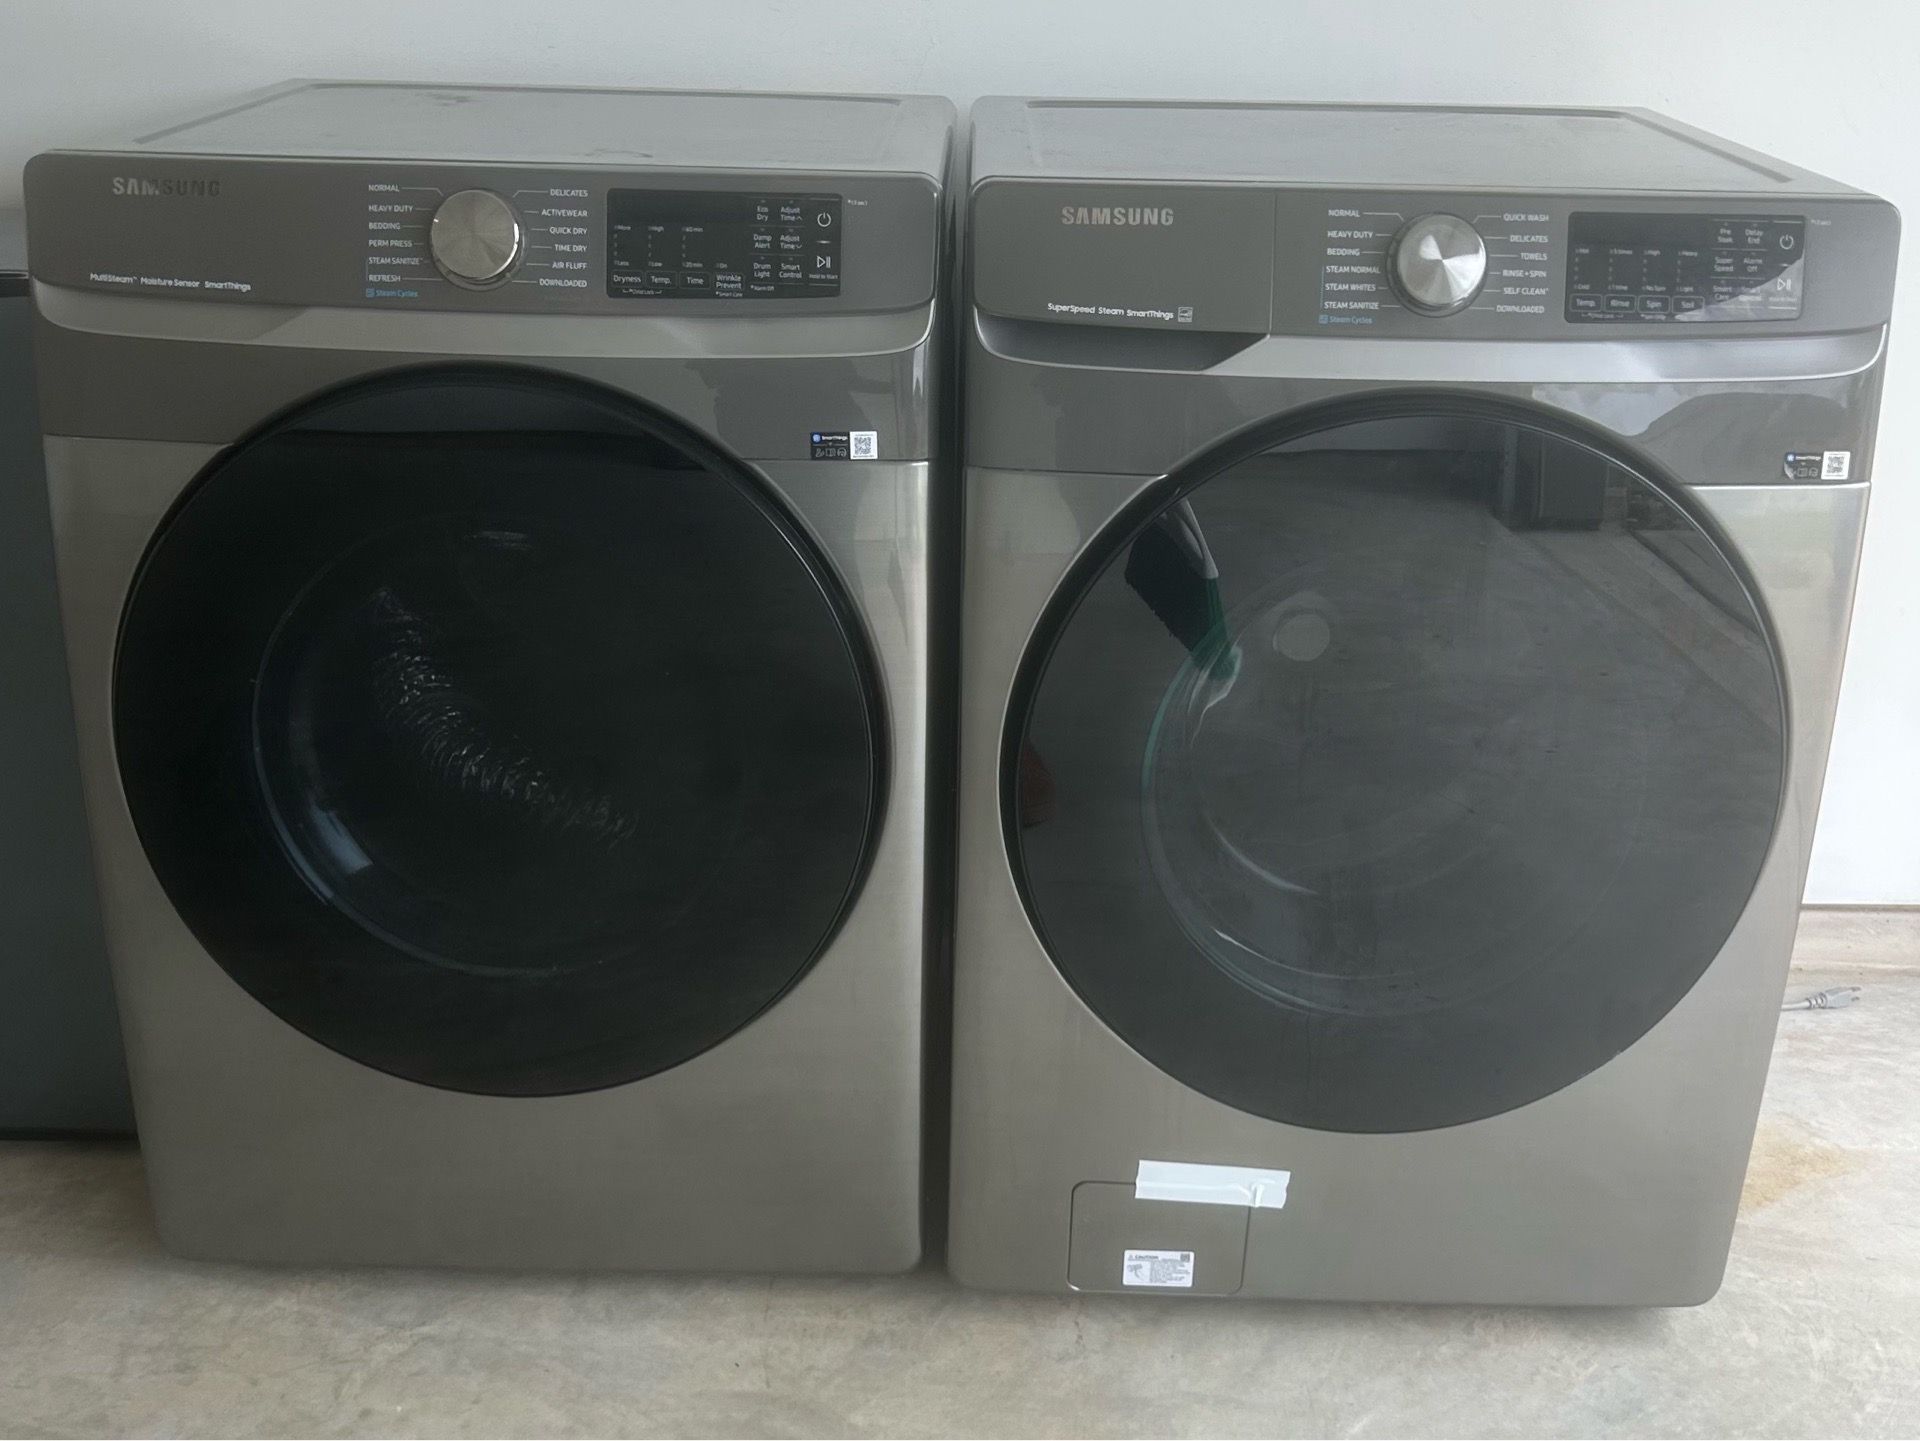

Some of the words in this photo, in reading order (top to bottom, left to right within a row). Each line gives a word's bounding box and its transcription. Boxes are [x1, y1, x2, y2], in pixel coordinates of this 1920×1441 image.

[112, 176, 221, 197] SAMSUNG
[368, 184, 400, 193] NORMAL
[550, 188, 589, 198] DELICATES
[368, 205, 392, 213] HEAVY
[393, 205, 414, 213] DUTY
[541, 208, 588, 217] ACTIVEWEAR
[780, 206, 801, 214] Adjust
[1328, 209, 1360, 217] NORMAL
[756, 214, 769, 222] Dry
[1061, 206, 1175, 226] SAMSUNG
[1503, 213, 1527, 221] QUICK
[1527, 213, 1549, 222] WASH
[368, 222, 401, 230] BEDDING
[549, 226, 571, 235] QUICK
[572, 227, 588, 235] DRY
[753, 233, 772, 242] Damp
[780, 234, 800, 243] Adjust
[1327, 230, 1354, 239] HEAVY
[1353, 231, 1374, 239] DUTY
[1510, 234, 1548, 243] DELICATES
[368, 239, 389, 248] PERM
[389, 239, 413, 248] PRESS
[554, 244, 571, 252] TIME
[1326, 247, 1360, 256] BEDDING
[368, 257, 391, 265] STEAM
[1520, 252, 1548, 261] TOWELS
[565, 262, 588, 270] FLUFF
[753, 262, 772, 270] Drum
[781, 263, 801, 271] Smart
[1325, 265, 1350, 273] STEAM
[1350, 266, 1381, 274] NORMAL
[753, 271, 771, 279] Light
[778, 271, 803, 279] Control
[1502, 269, 1524, 278] RINSE
[1529, 270, 1547, 278] SPIN
[368, 274, 401, 283] REFRESH
[539, 278, 588, 288] DOWNLOADED
[613, 275, 642, 283] Dryness
[687, 276, 705, 285] Time
[140, 276, 173, 287] Moisture
[173, 278, 200, 288] Sensor
[204, 280, 251, 293] SmartThings
[716, 281, 742, 289] Prevent
[1325, 283, 1349, 291] STEAM
[1350, 284, 1377, 292] WHITES
[376, 289, 397, 297] Steam
[397, 290, 418, 298] Cycles
[1503, 287, 1521, 295] SELF
[1323, 301, 1349, 309] STEAM
[1349, 302, 1380, 310] SANITIZE
[1496, 305, 1545, 313] DOWNLOADED
[1047, 302, 1096, 314] SuperSpeed
[1098, 306, 1125, 315] Steam
[1126, 309, 1174, 320] SmartThings
